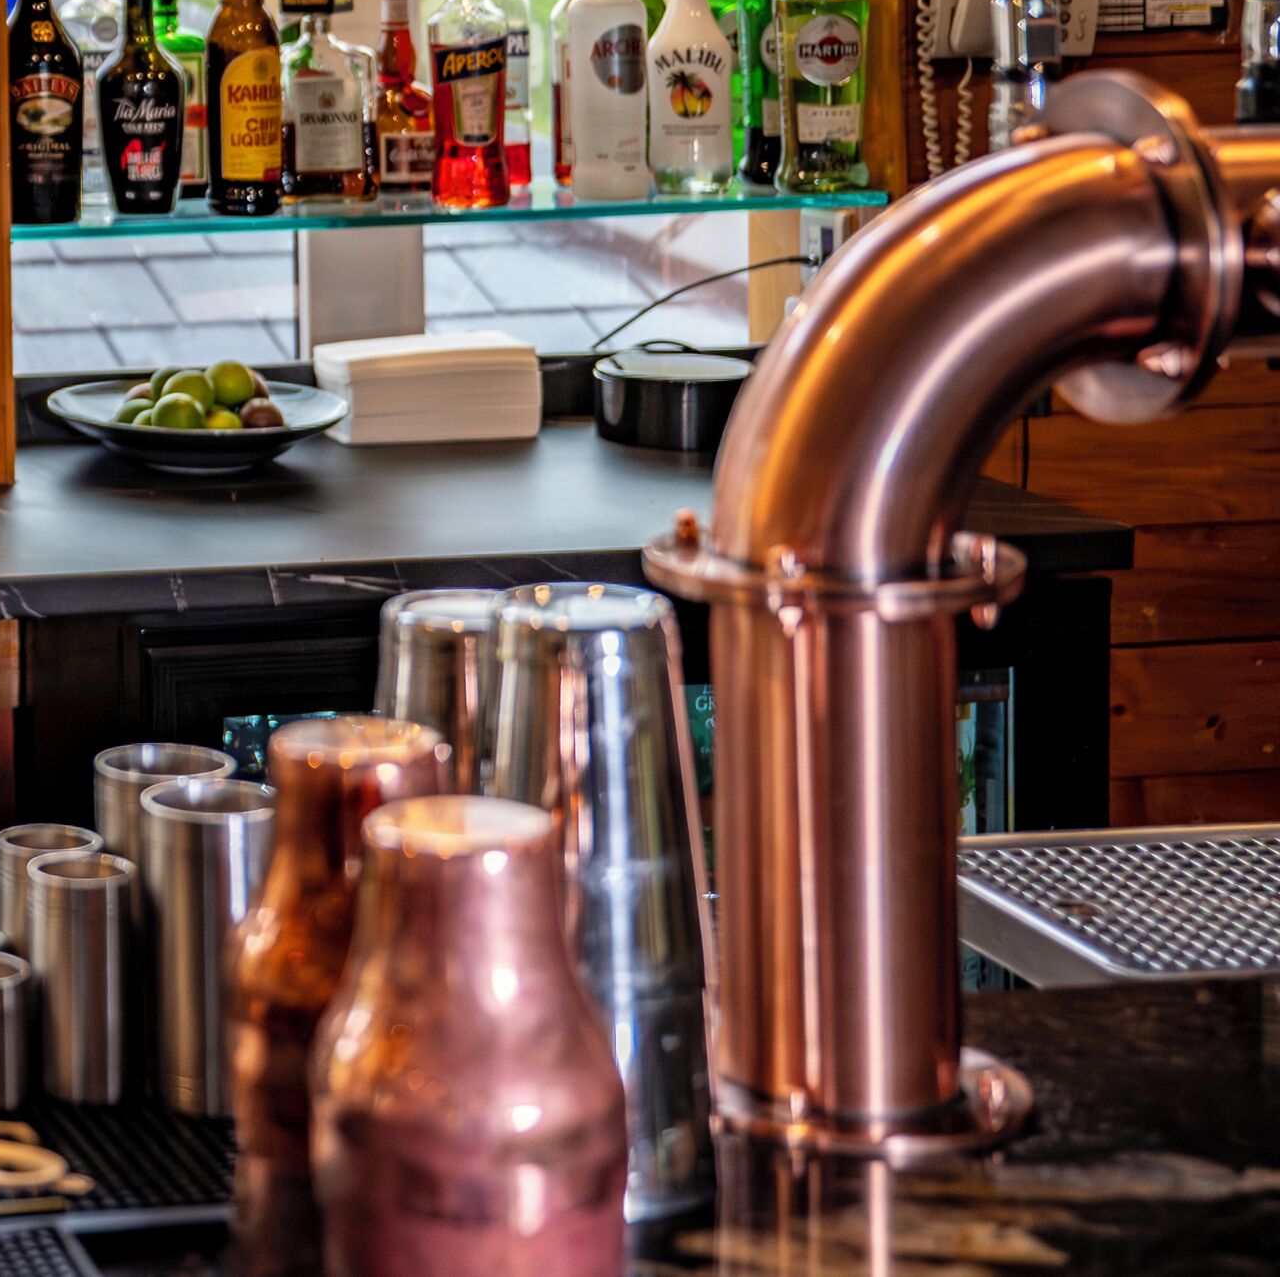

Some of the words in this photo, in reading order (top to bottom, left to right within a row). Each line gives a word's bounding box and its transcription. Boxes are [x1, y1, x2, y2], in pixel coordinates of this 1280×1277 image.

[654, 48, 726, 73] MALIBU
[800, 42, 859, 58] MARTINI
[441, 47, 505, 77] APEROL
[11, 78, 76, 98] BAILEYS
[131, 99, 176, 122] Maria
